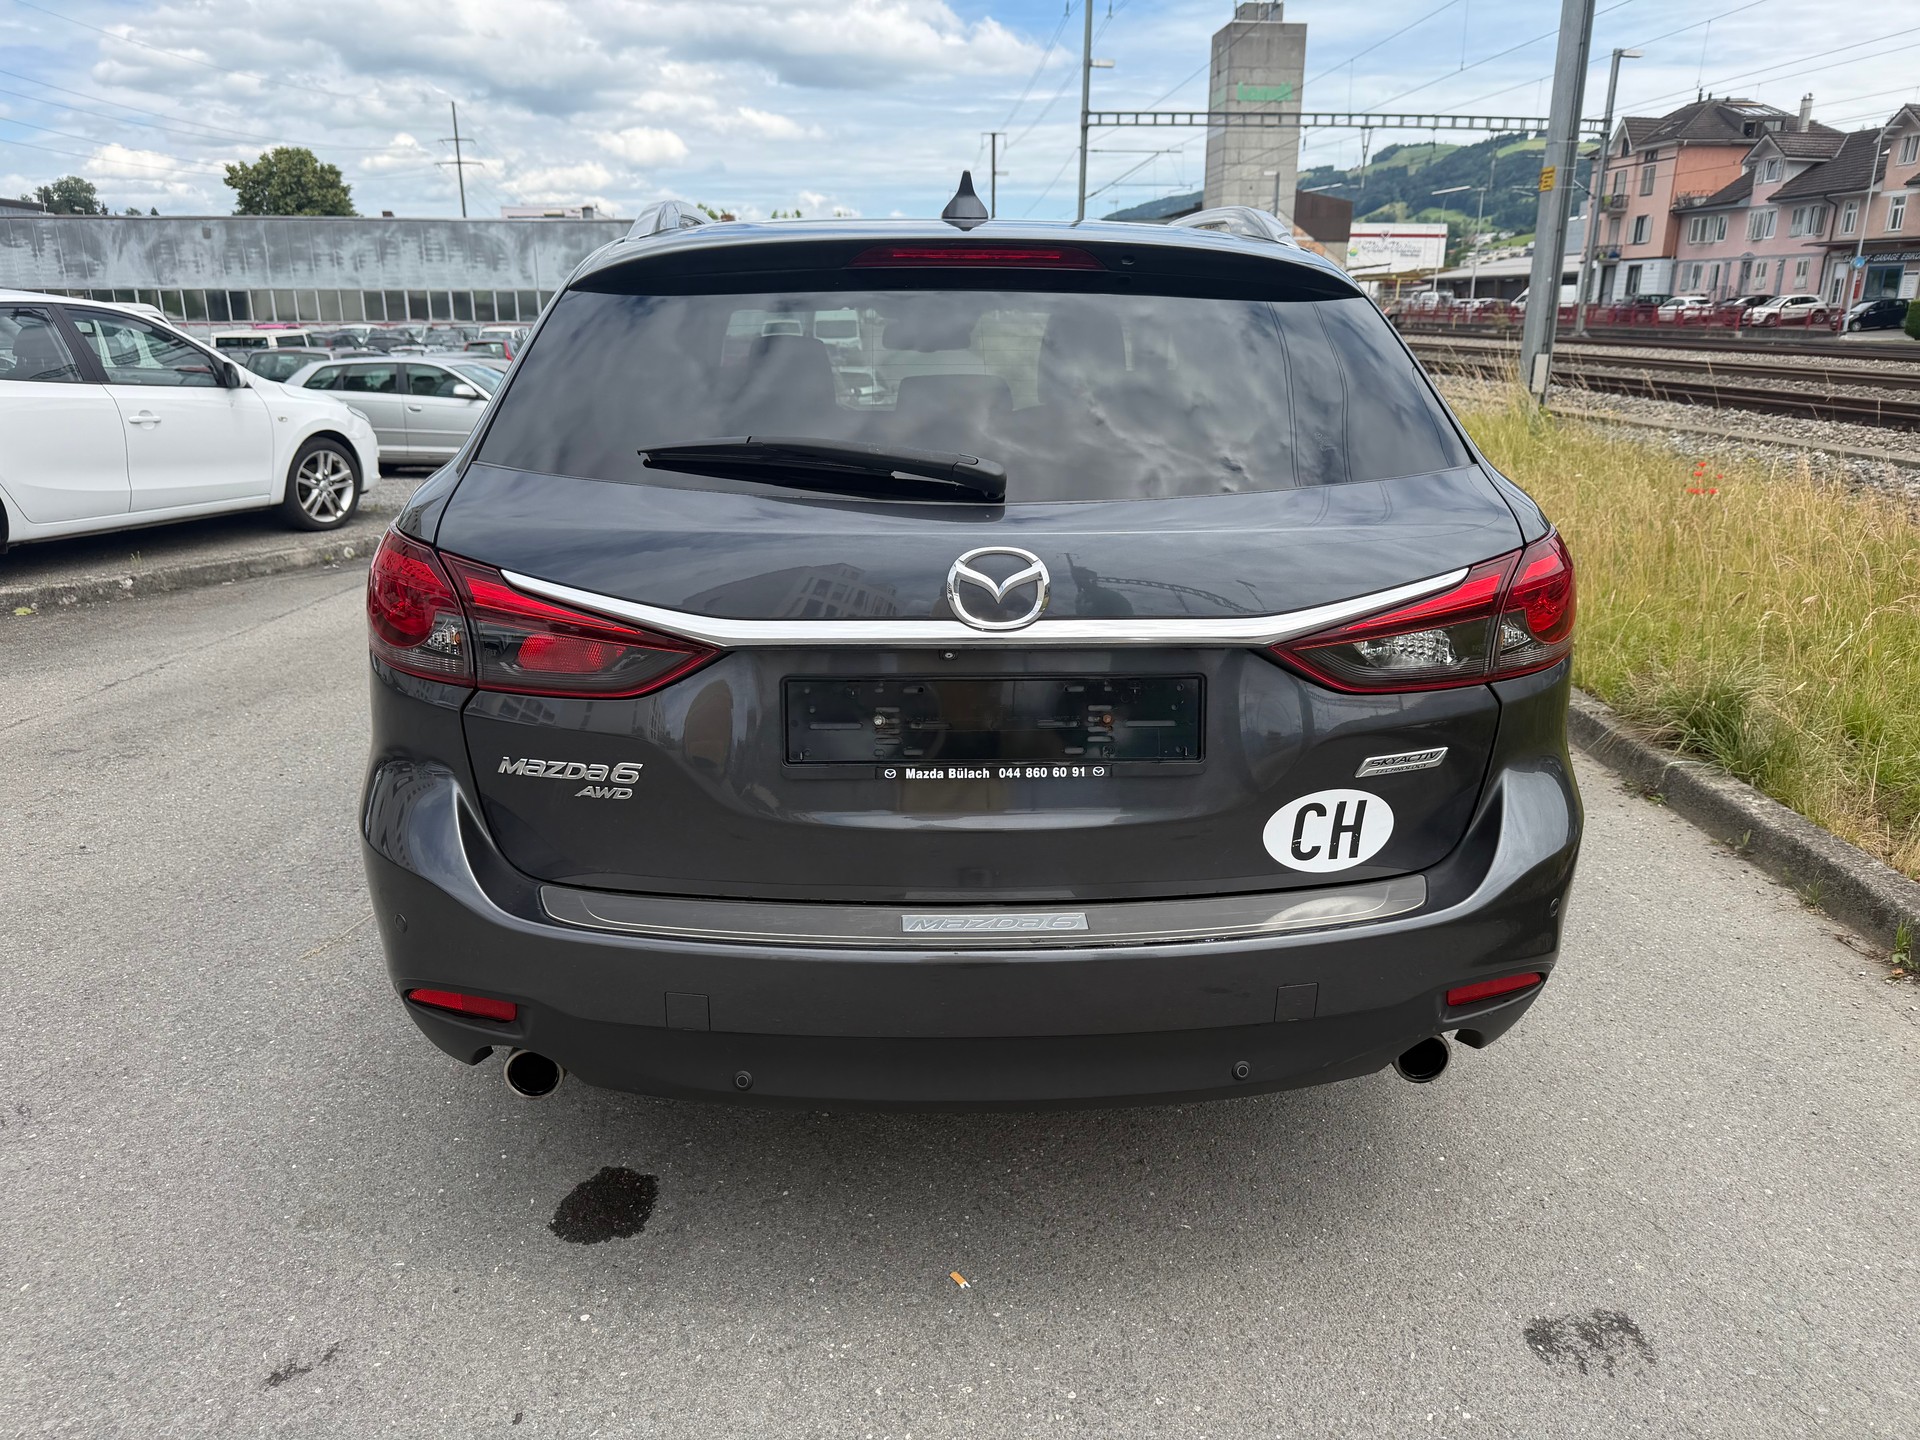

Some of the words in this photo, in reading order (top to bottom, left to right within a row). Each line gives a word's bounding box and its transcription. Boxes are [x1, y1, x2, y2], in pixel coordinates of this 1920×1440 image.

[1371, 751, 1439, 767] SKYACTIV
[905, 768, 944, 779] Mazda
[948, 767, 990, 779] Bülach
[998, 767, 1021, 778] 044
[1025, 767, 1048, 778] 860
[1052, 766, 1067, 778] 60
[1071, 766, 1085, 777] 91
[1375, 763, 1429, 774] TECHNOLOGY
[574, 785, 633, 800] AWD
[1290, 799, 1368, 861] CH
